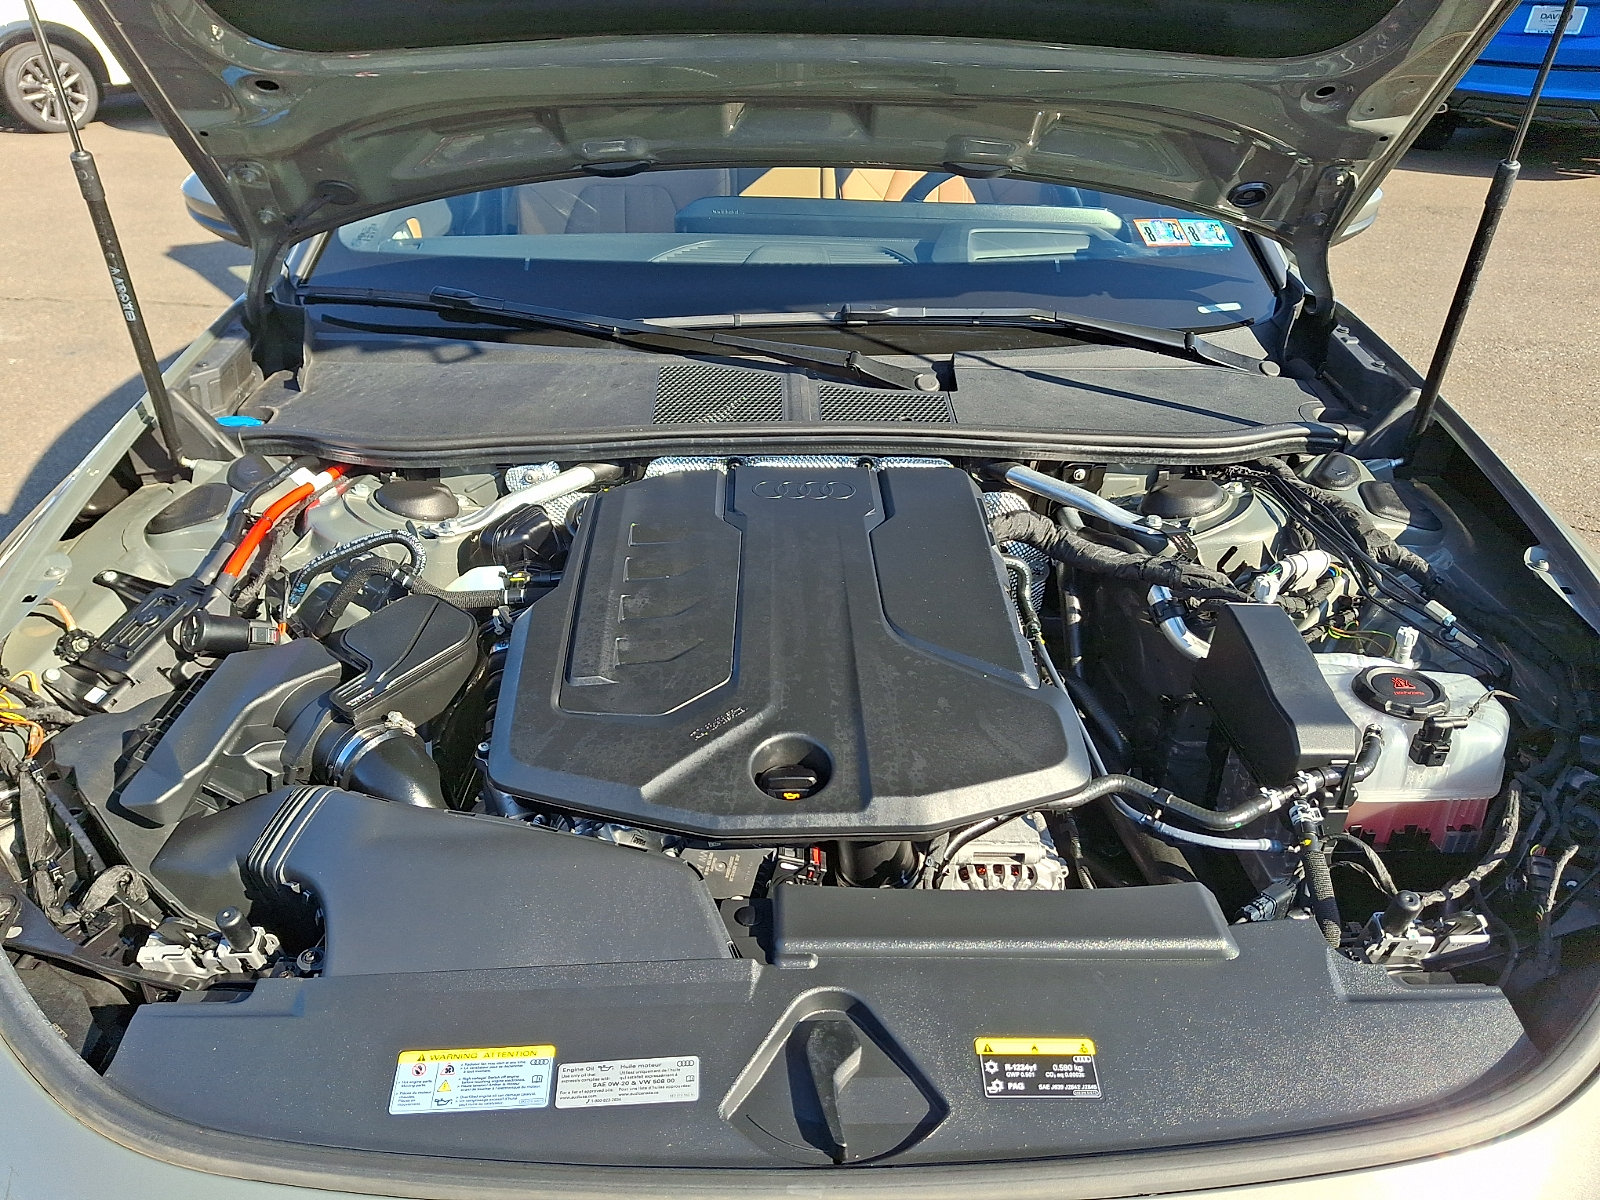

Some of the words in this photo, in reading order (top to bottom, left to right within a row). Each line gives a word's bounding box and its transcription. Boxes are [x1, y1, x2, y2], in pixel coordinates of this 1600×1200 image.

[430, 1053, 478, 1061] WARNING
[484, 1050, 537, 1058] ATTENTION
[1004, 1063, 1037, 1072] R-1234yf
[1074, 1063, 1084, 1073] kg
[1007, 1082, 1025, 1090] PAG
